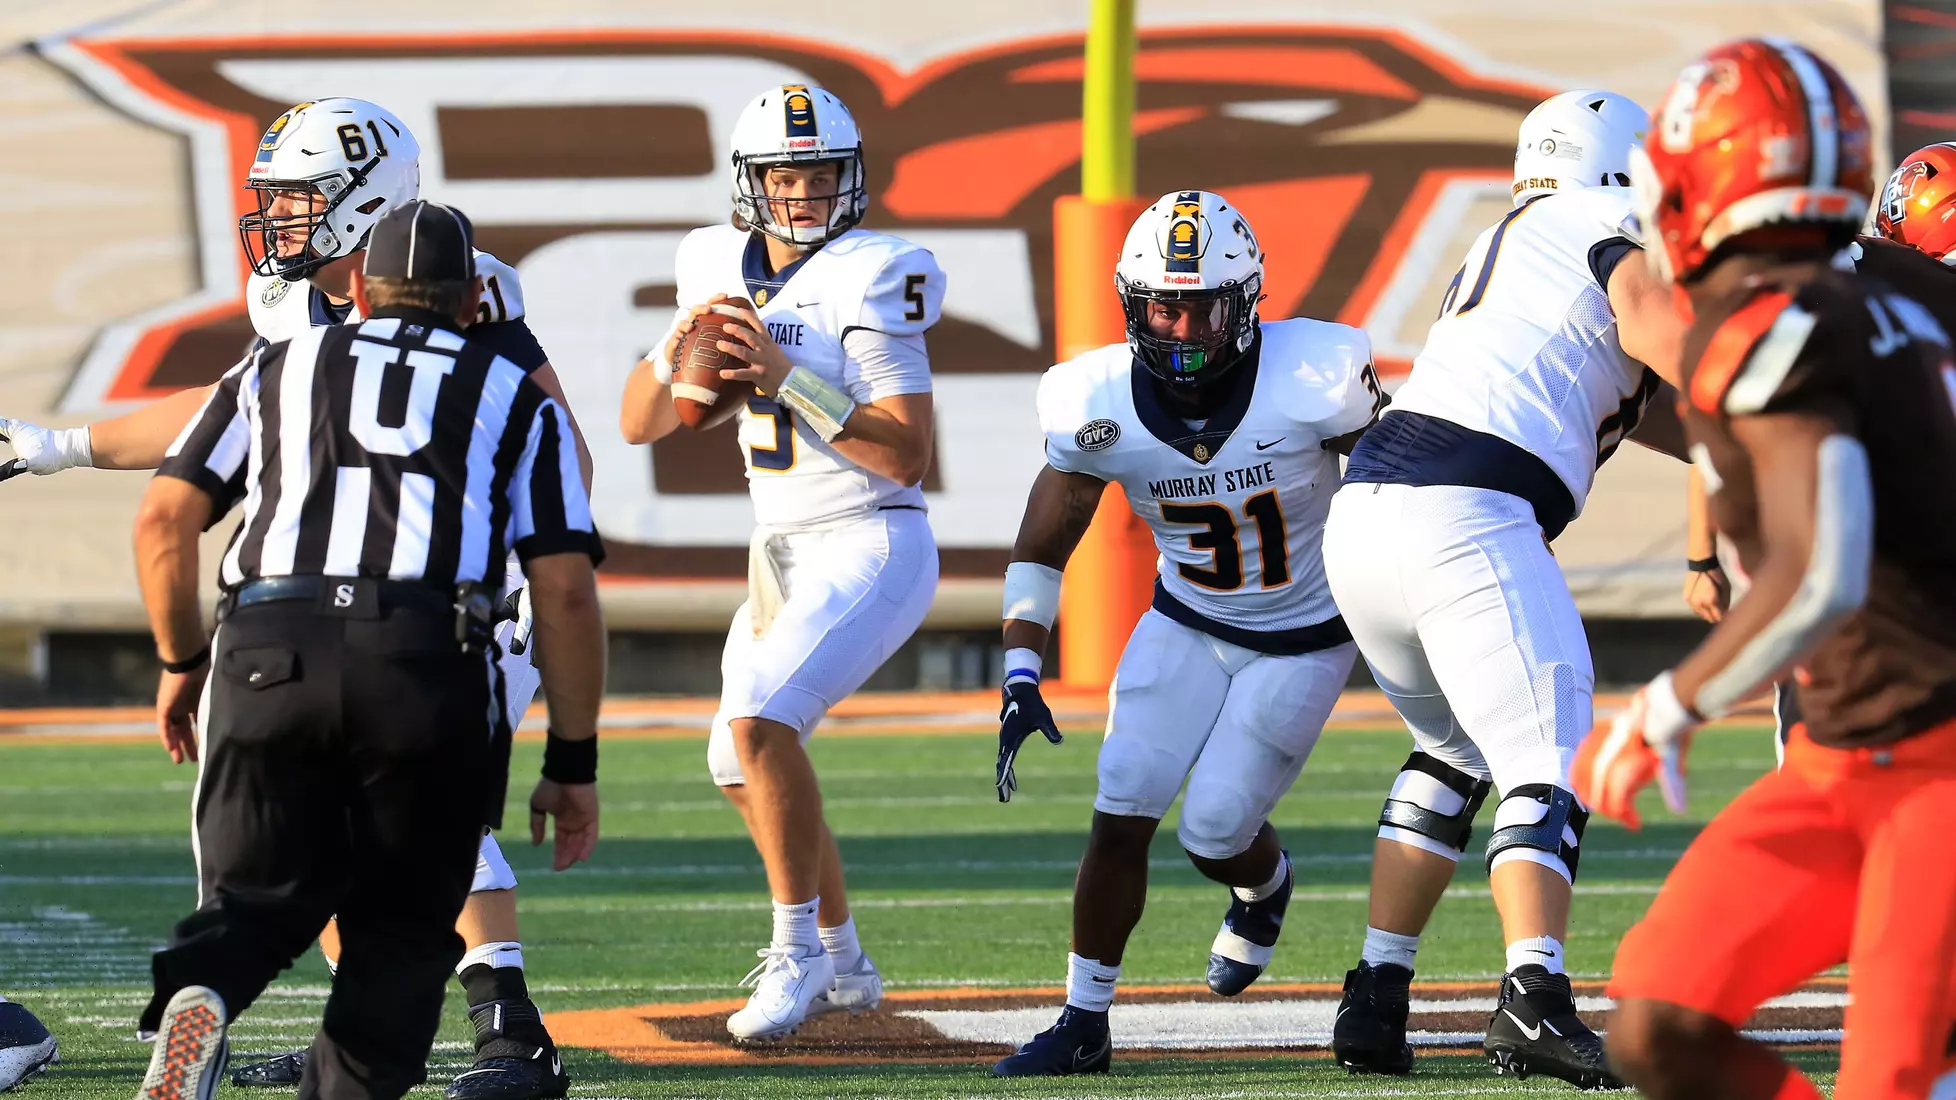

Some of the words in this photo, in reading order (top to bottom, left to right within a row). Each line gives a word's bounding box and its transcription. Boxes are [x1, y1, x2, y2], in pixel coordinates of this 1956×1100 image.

[336, 119, 389, 162] 61
[1530, 177, 1558, 190] STATE
[1164, 275, 1201, 285] Riddell
[904, 273, 927, 322] 5
[767, 322, 804, 346] STATE
[348, 339, 457, 458] U
[1084, 426, 1110, 445] OVC
[1148, 474, 1217, 499] MURRAY
[1224, 461, 1276, 493] STATE
[1159, 487, 1293, 593] 31
[334, 583, 355, 608] S
